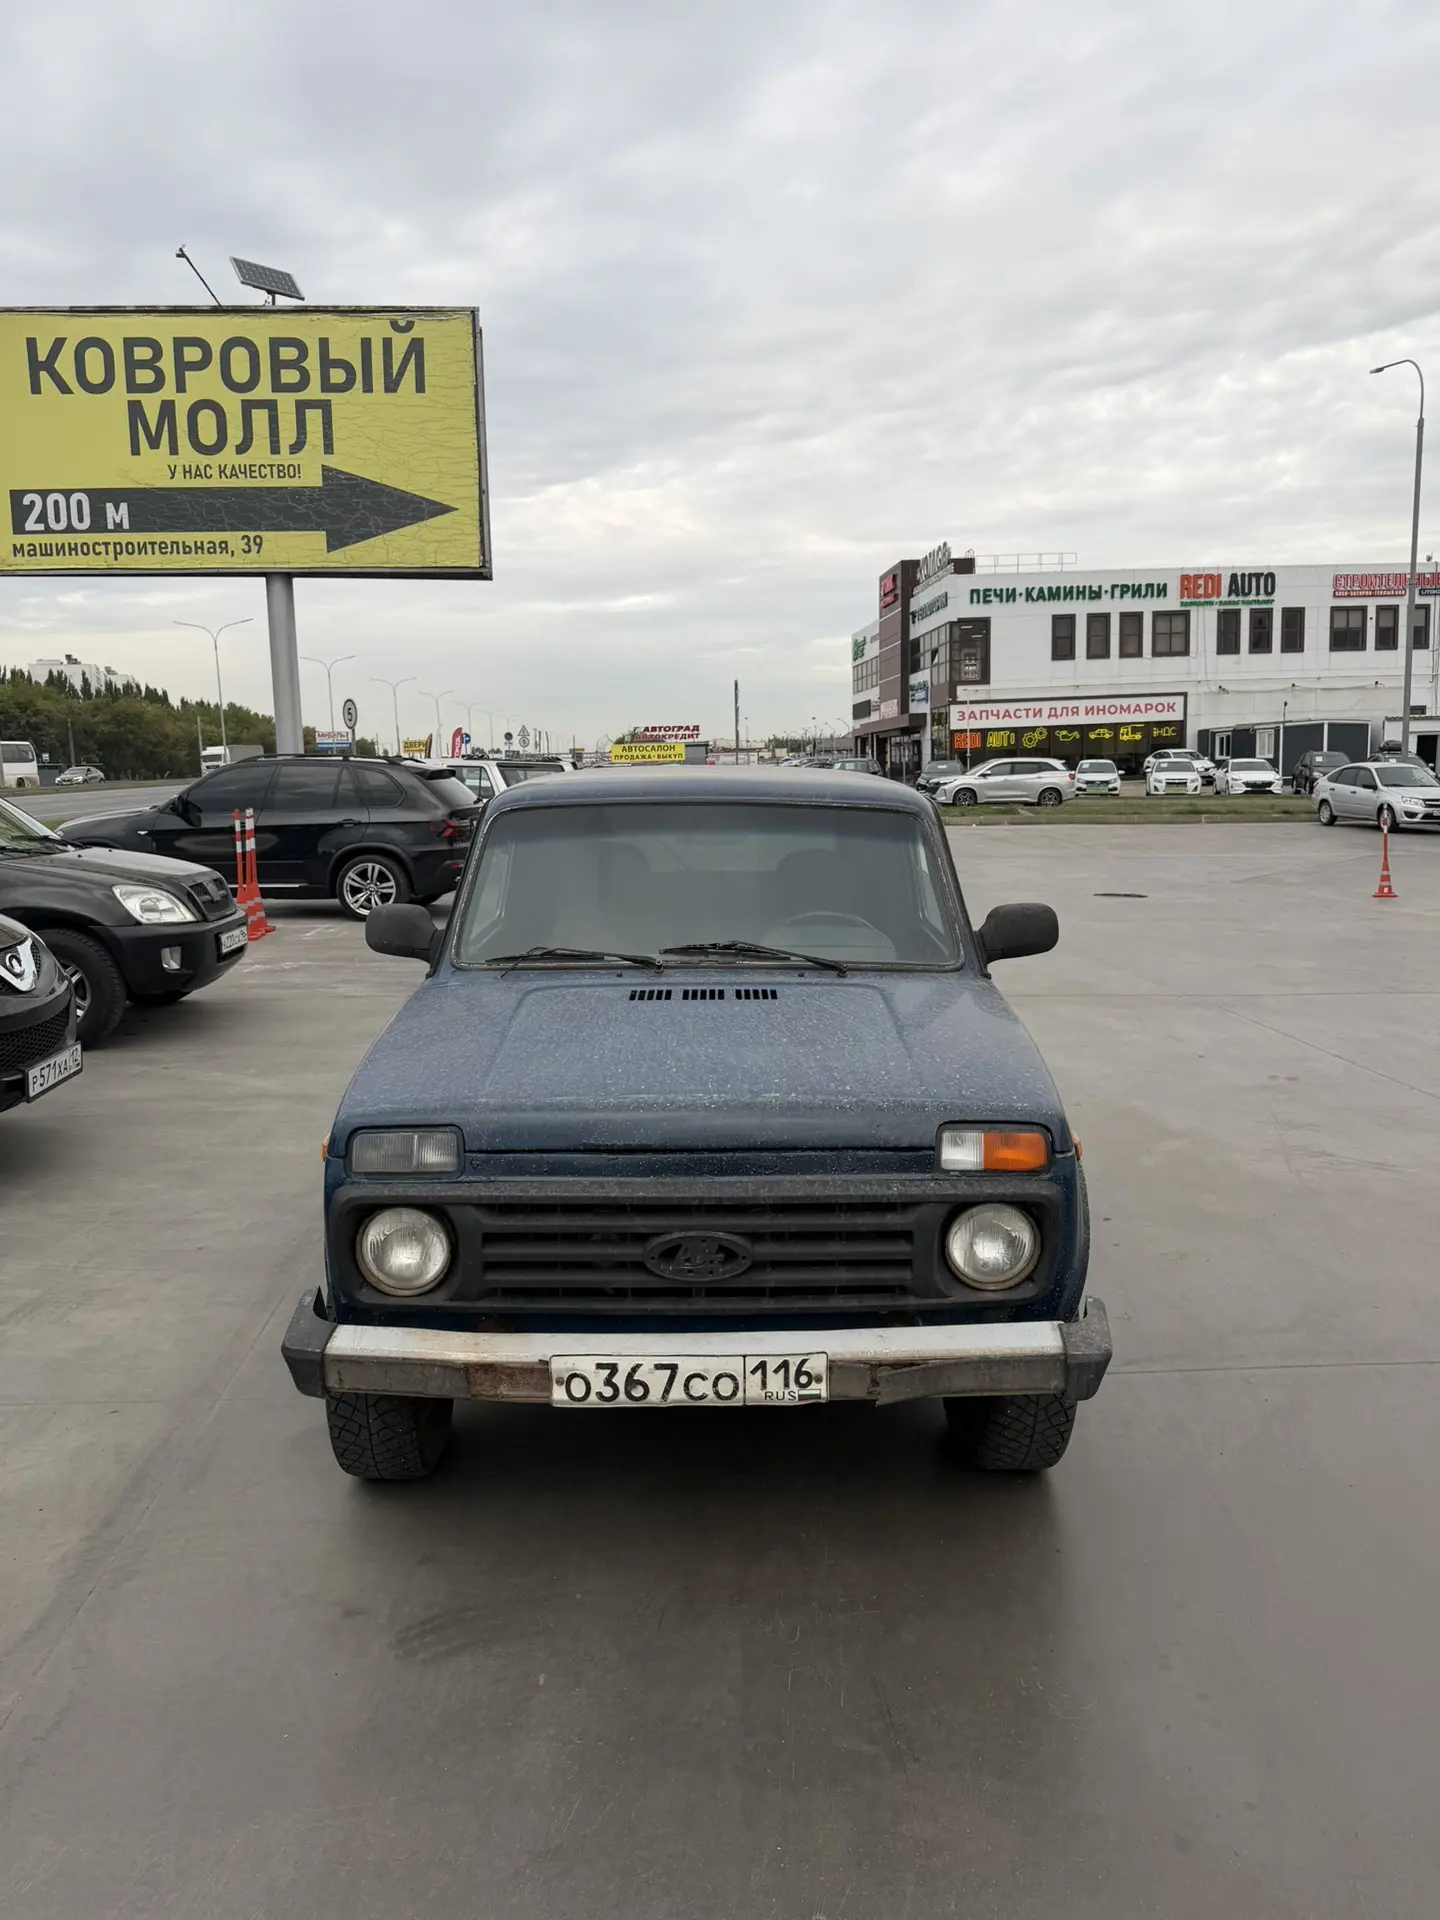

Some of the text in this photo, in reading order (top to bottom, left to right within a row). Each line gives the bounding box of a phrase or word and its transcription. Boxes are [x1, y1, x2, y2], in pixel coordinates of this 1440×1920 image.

[25, 319, 427, 396] КОВРОВЫЙ
[128, 398, 335, 457] МОЛЛ
[167, 463, 302, 480] У НАС КАЧЕСТВО!
[22, 492, 90, 532] 200
[12, 535, 264, 561] машиностроительная, 39
[1180, 572, 1276, 599] REDI AUTO
[347, 707, 353, 722] 5
[957, 702, 1176, 722] ЗАПЧАСТИ ДЛЯ ИНОМАРОК
[643, 725, 700, 733] АВТОГРАД
[621, 744, 676, 753] АВТОСАЛОН
[32, 1057, 69, 1093] Р571ХА
[749, 1358, 813, 1390] 116
[763, 1389, 797, 1402] RUS
